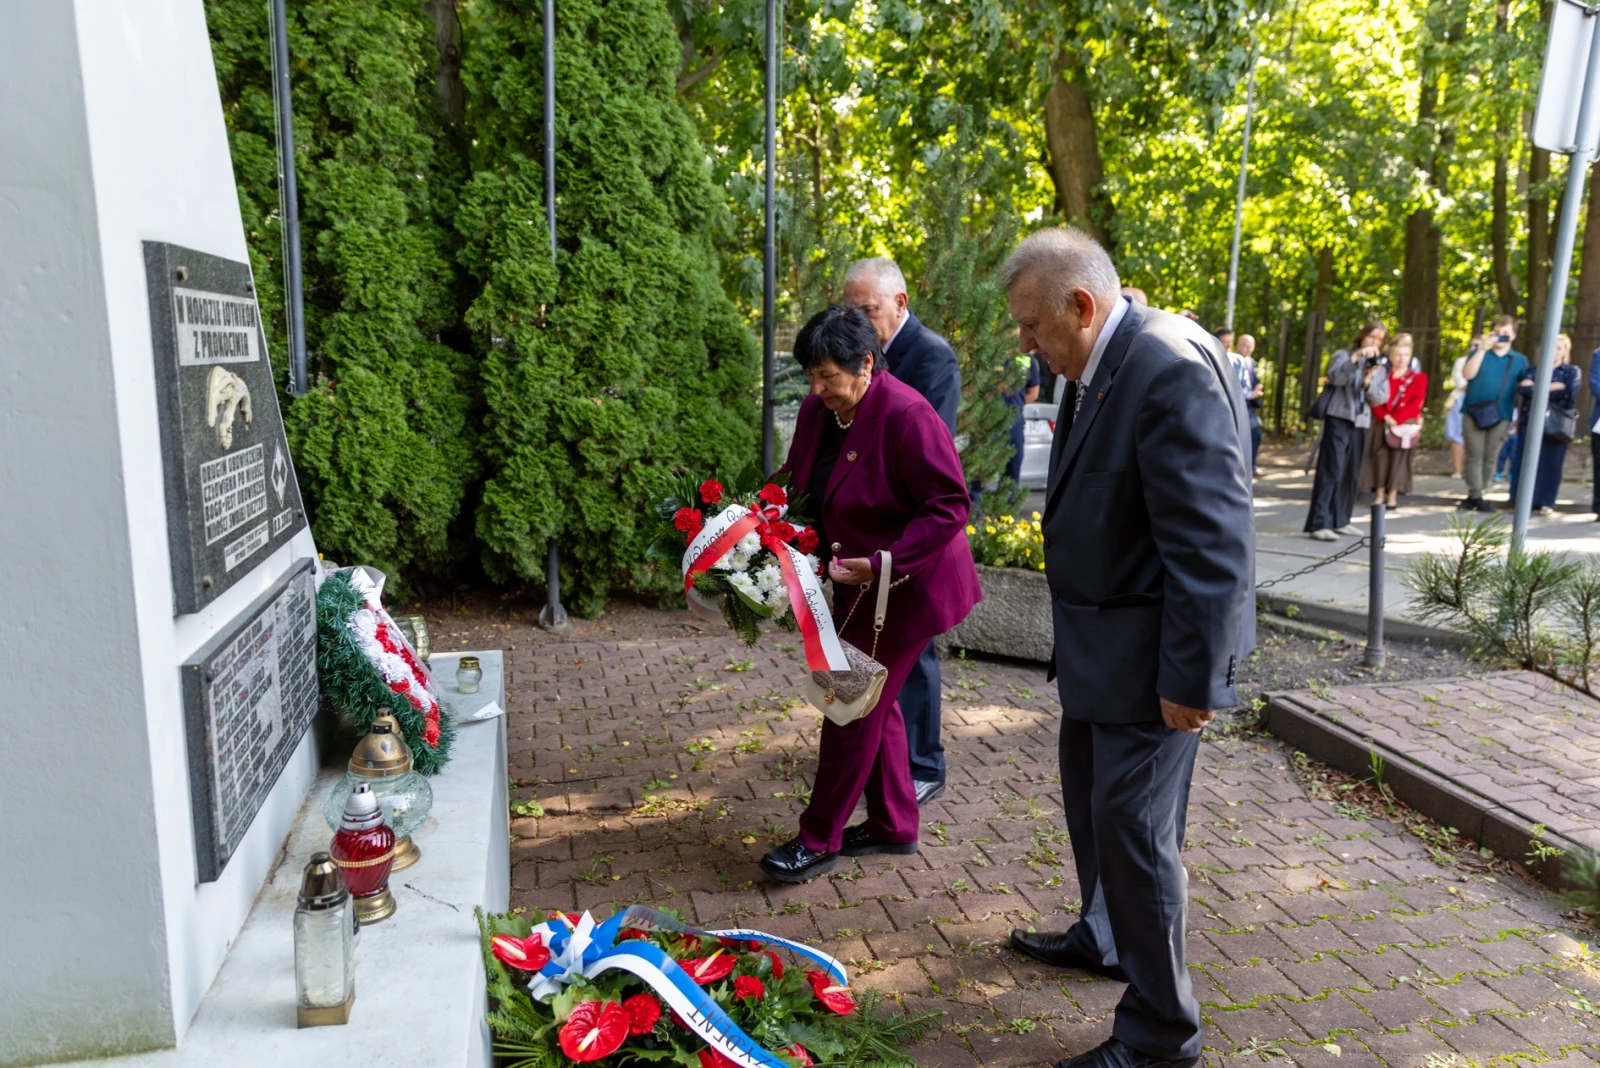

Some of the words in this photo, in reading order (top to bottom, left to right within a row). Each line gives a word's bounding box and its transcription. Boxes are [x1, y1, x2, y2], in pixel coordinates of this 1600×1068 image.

[175, 295, 185, 324] W
[193, 331, 200, 358] Z
[200, 331, 249, 358] PROKOCIMIA
